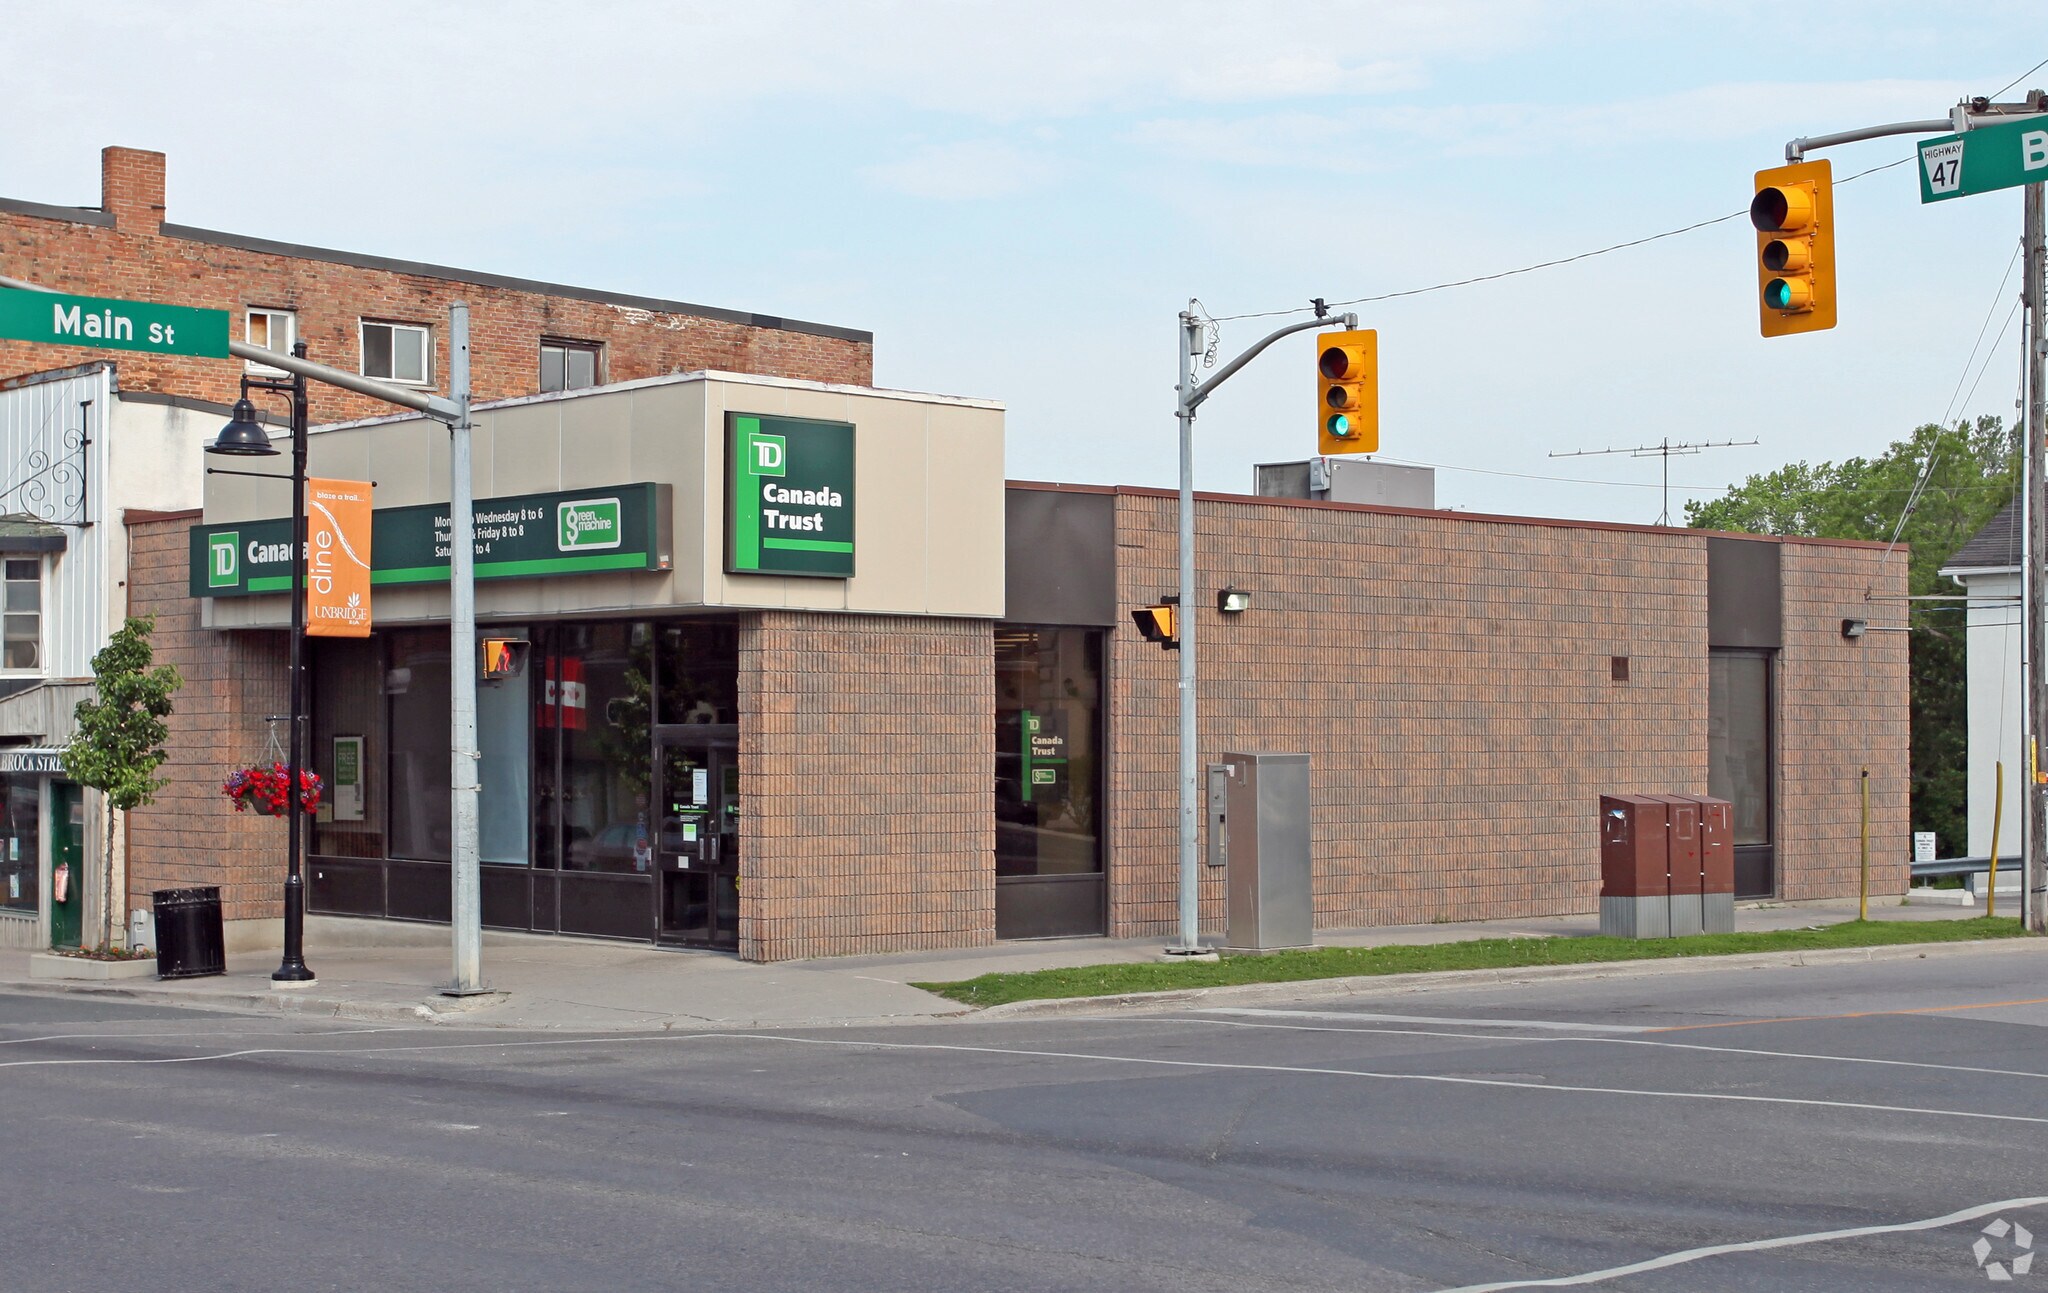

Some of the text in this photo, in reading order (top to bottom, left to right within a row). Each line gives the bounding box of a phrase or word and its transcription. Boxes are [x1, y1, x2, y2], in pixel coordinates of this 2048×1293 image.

[1924, 144, 1962, 159] HIGHWAY
[1932, 159, 1959, 187] 47
[54, 303, 175, 345] Main St
[752, 441, 782, 468] TD
[316, 492, 336, 500] blaze
[763, 483, 842, 507] Canada
[475, 510, 519, 524] Wednesday
[520, 509, 526, 520] 8
[527, 510, 536, 520] to
[537, 507, 543, 519] 6
[763, 509, 824, 532] Trust
[477, 526, 500, 541] Friday
[501, 526, 507, 537] 8
[508, 526, 517, 537] to
[518, 524, 524, 536] 8
[578, 517, 613, 532] machine
[475, 543, 484, 554] to
[485, 542, 490, 553] 4
[212, 543, 236, 576] TD
[310, 530, 332, 594] dine
[315, 606, 368, 620] UXBRIDGE
[1027, 719, 1039, 730] TD
[1031, 735, 1063, 745] Canada
[1031, 747, 1056, 756] Trust
[1, 753, 34, 771] BROCK
